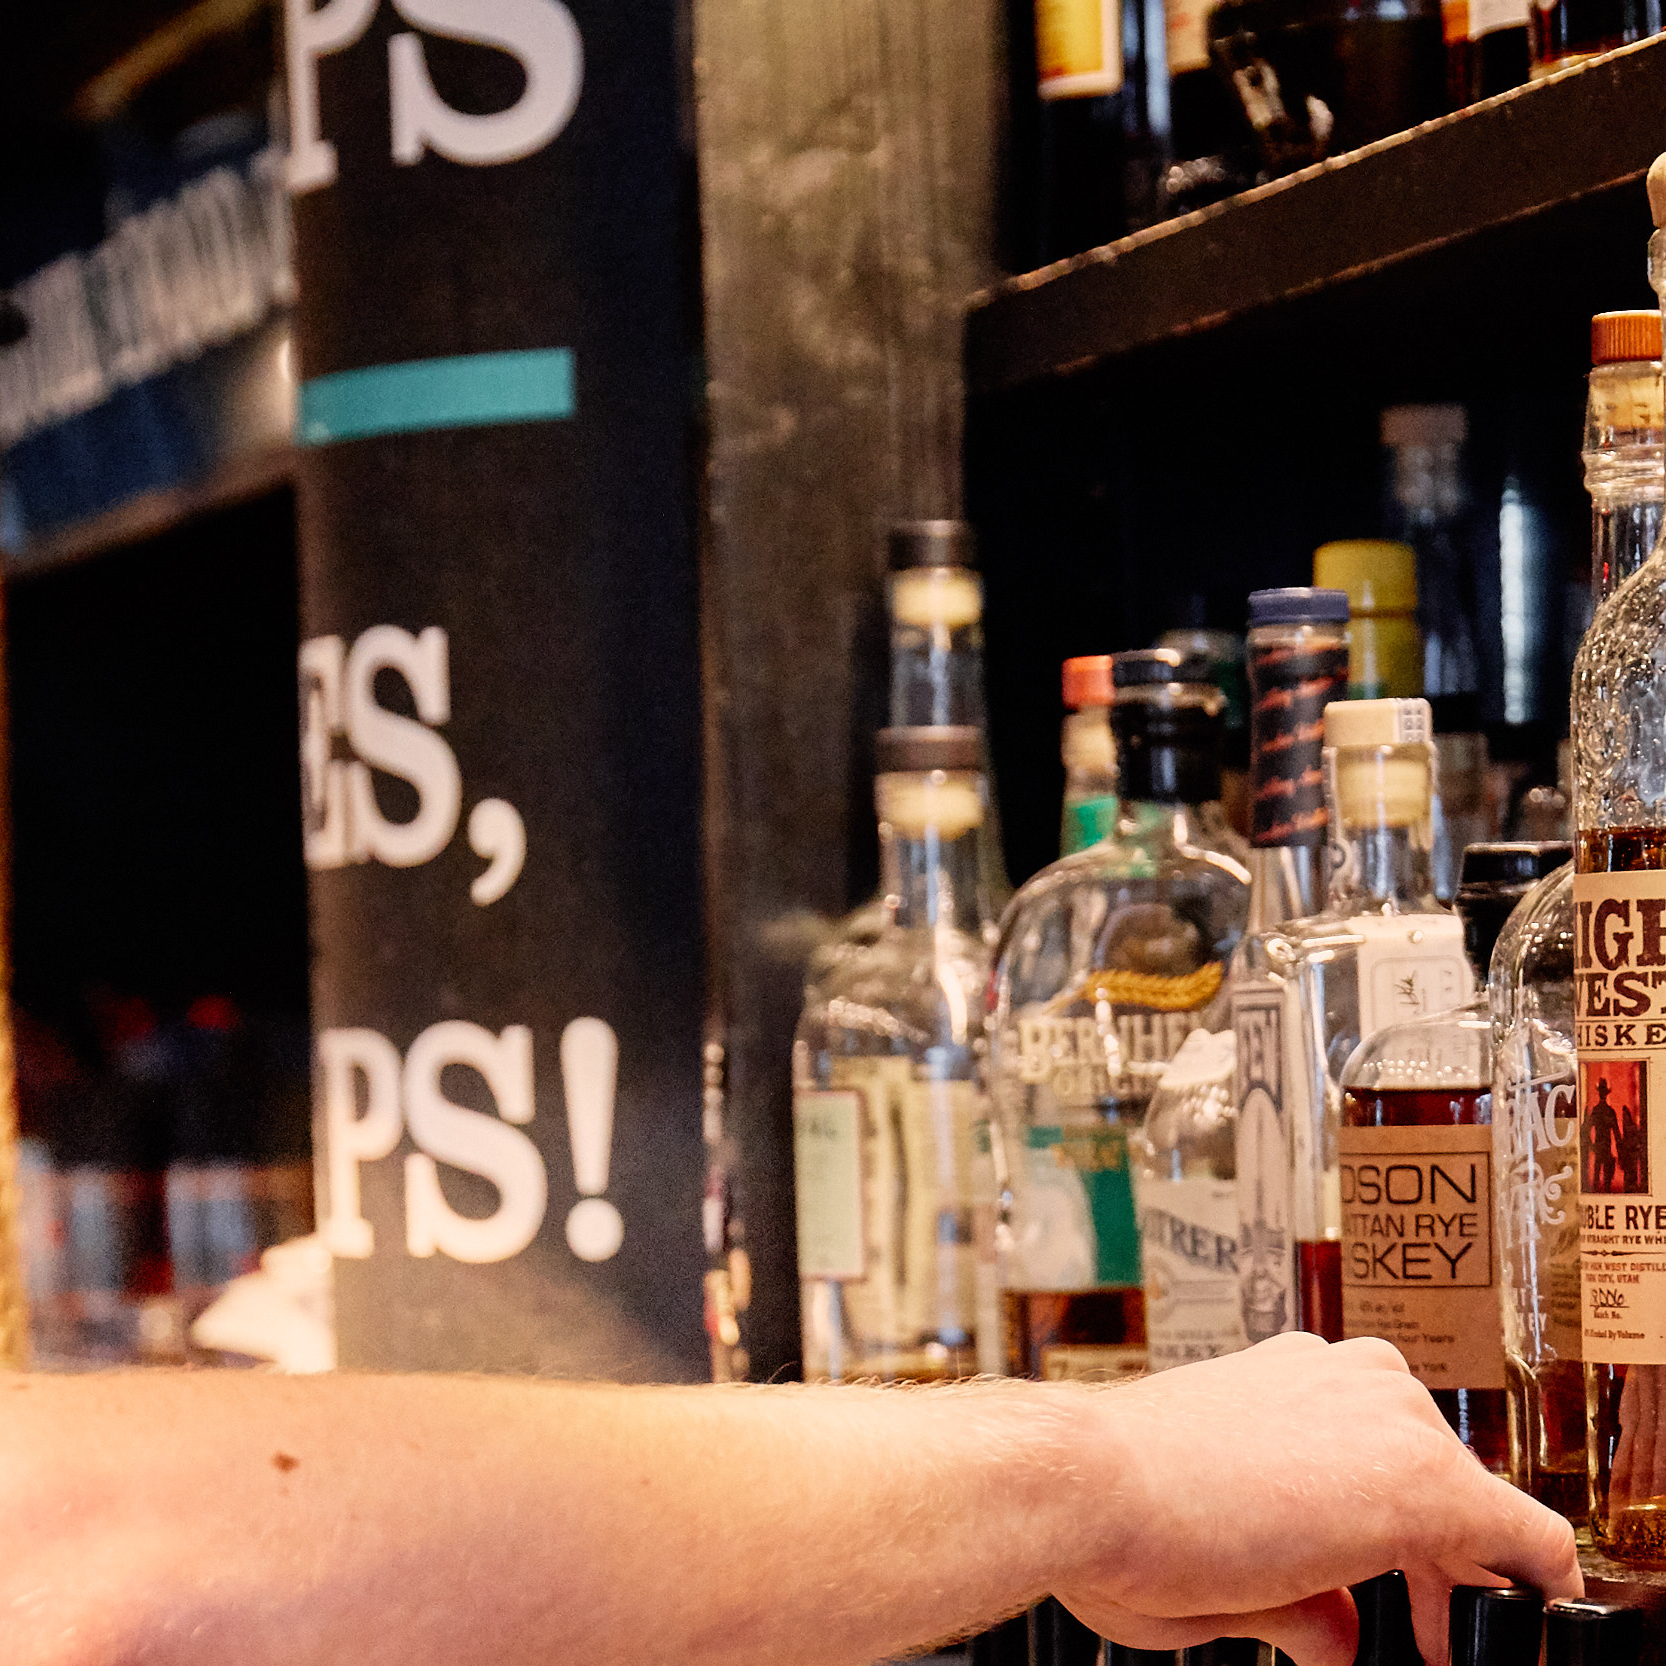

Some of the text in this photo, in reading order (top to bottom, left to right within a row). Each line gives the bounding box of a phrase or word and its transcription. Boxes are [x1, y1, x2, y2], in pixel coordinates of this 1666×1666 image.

[317, 1016, 625, 1264] PS!
[1415, 1212, 1478, 1237] RYE
[1582, 1205, 1616, 1230] BLE
[1622, 1234, 1642, 1244] RYE
[1605, 1262, 1627, 1271] WEST
[1617, 1273, 1640, 1284] UTAH
